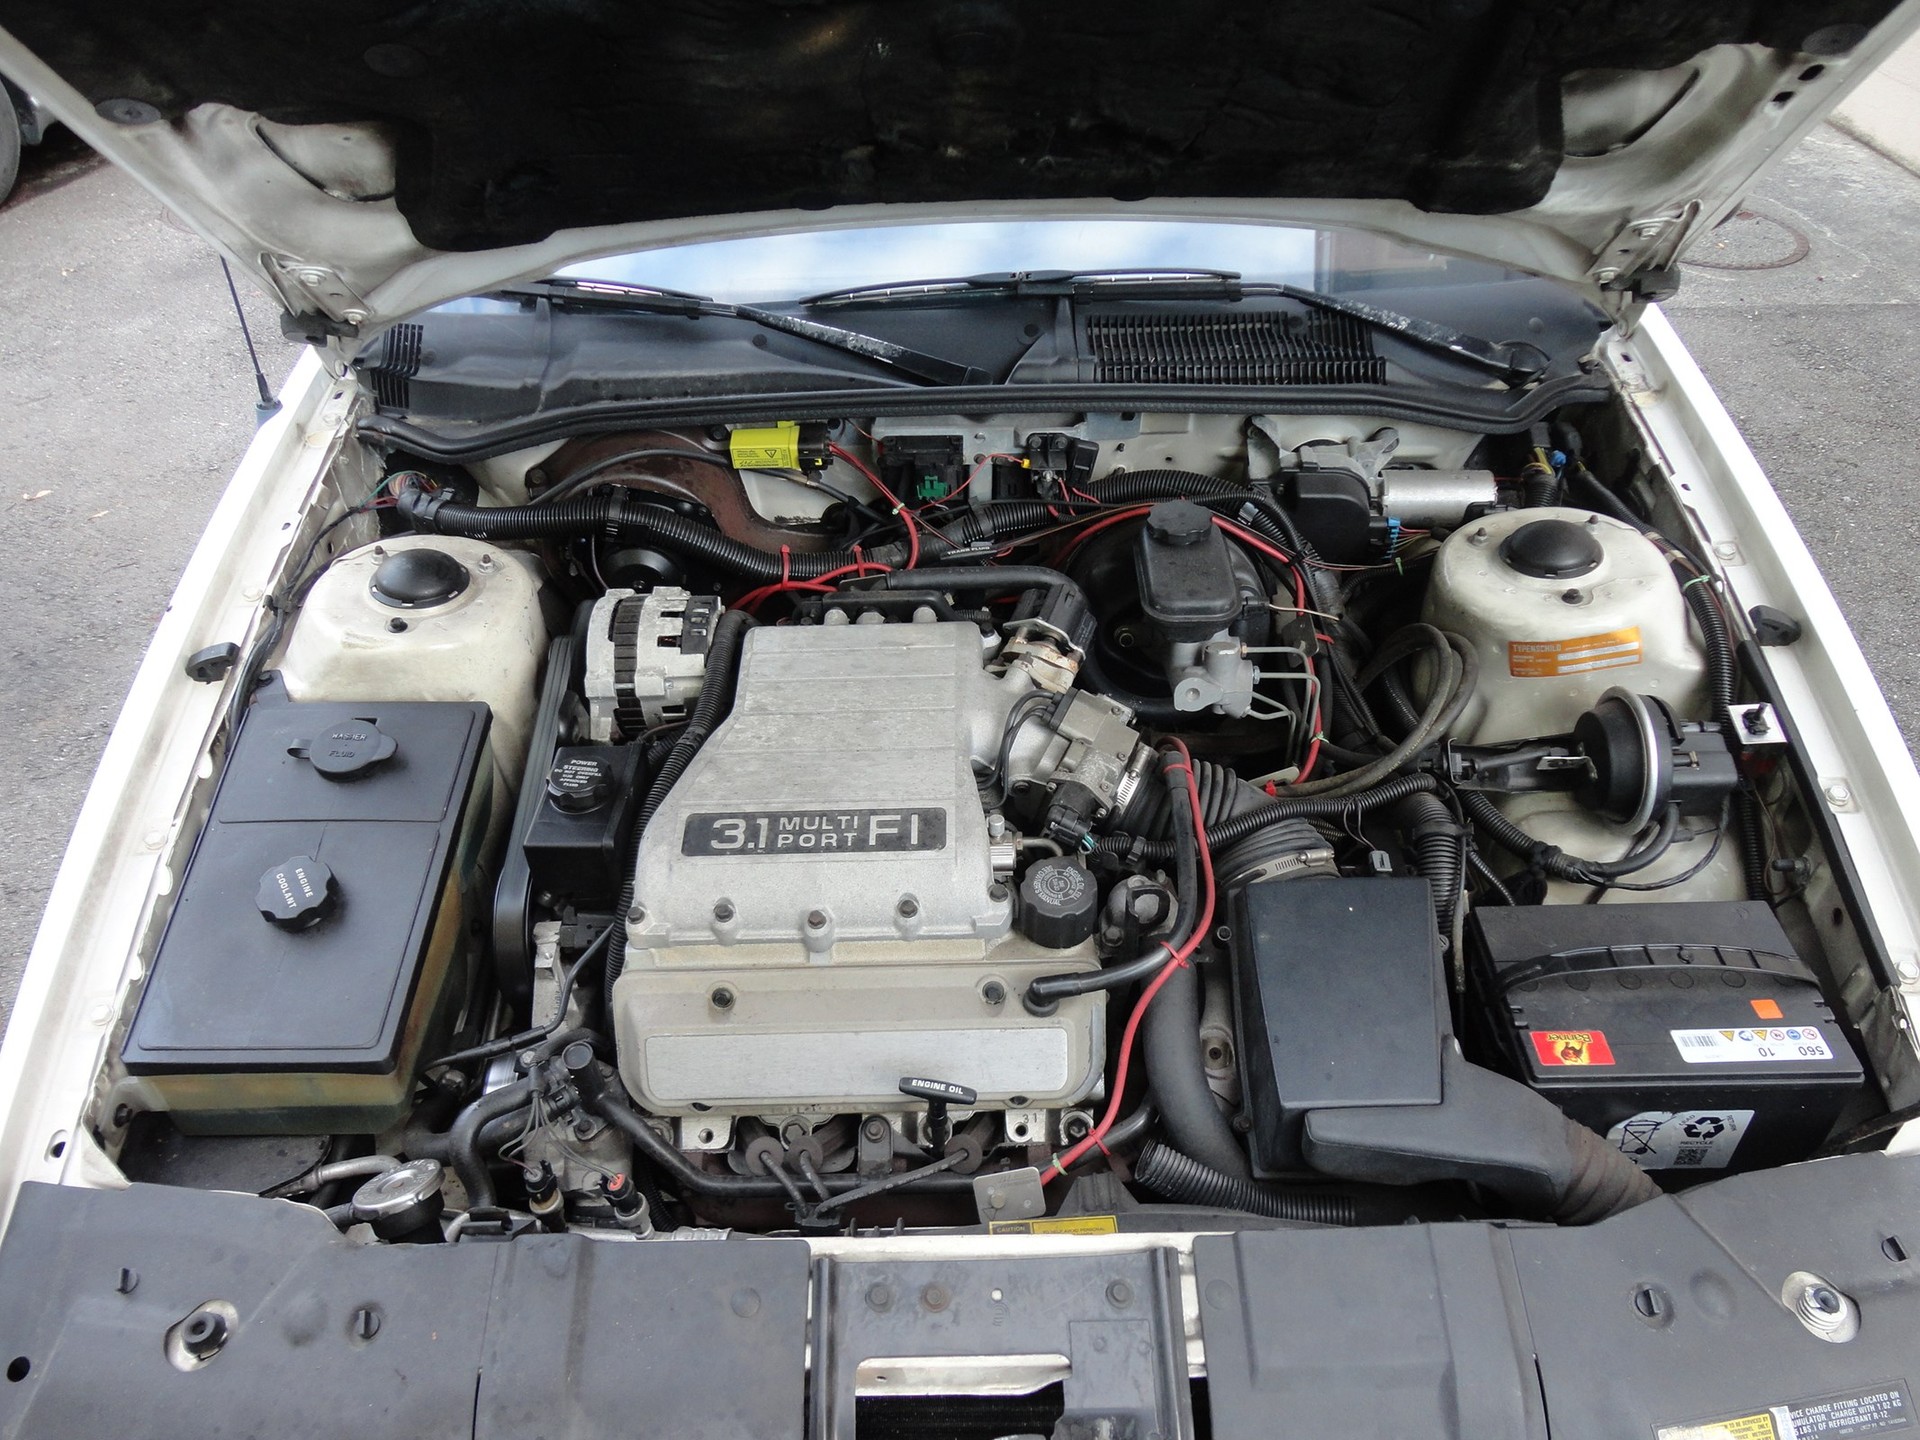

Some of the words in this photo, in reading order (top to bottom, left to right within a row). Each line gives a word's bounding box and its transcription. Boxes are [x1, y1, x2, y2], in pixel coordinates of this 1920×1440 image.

[1512, 644, 1562, 652] TYPENSCHILD
[332, 733, 367, 742] WASHER
[563, 764, 599, 772] STEERING
[779, 815, 859, 831] MULTI
[868, 814, 919, 846] FI
[710, 817, 769, 850] 3.1
[777, 832, 858, 848] PORT
[276, 872, 297, 908] COOLANT
[295, 868, 314, 898] ENGINE
[1548, 1033, 1592, 1042] Banner
[1758, 1048, 1775, 1057] 10
[1798, 1046, 1824, 1056] 560
[912, 1079, 946, 1091] ENGINE
[948, 1085, 964, 1094] OIL
[1806, 1404, 1832, 1416] CHARGE
[1834, 1399, 1859, 1411] FITTING
[1860, 1393, 1888, 1405] LOCATED
[1831, 1408, 1857, 1419] CHARGE
[1858, 1404, 1875, 1414] WITH
[1877, 1401, 1891, 1410] 1.02
[1893, 1399, 1902, 1407] KG
[1829, 1414, 1872, 1428] REFRIGERANT
